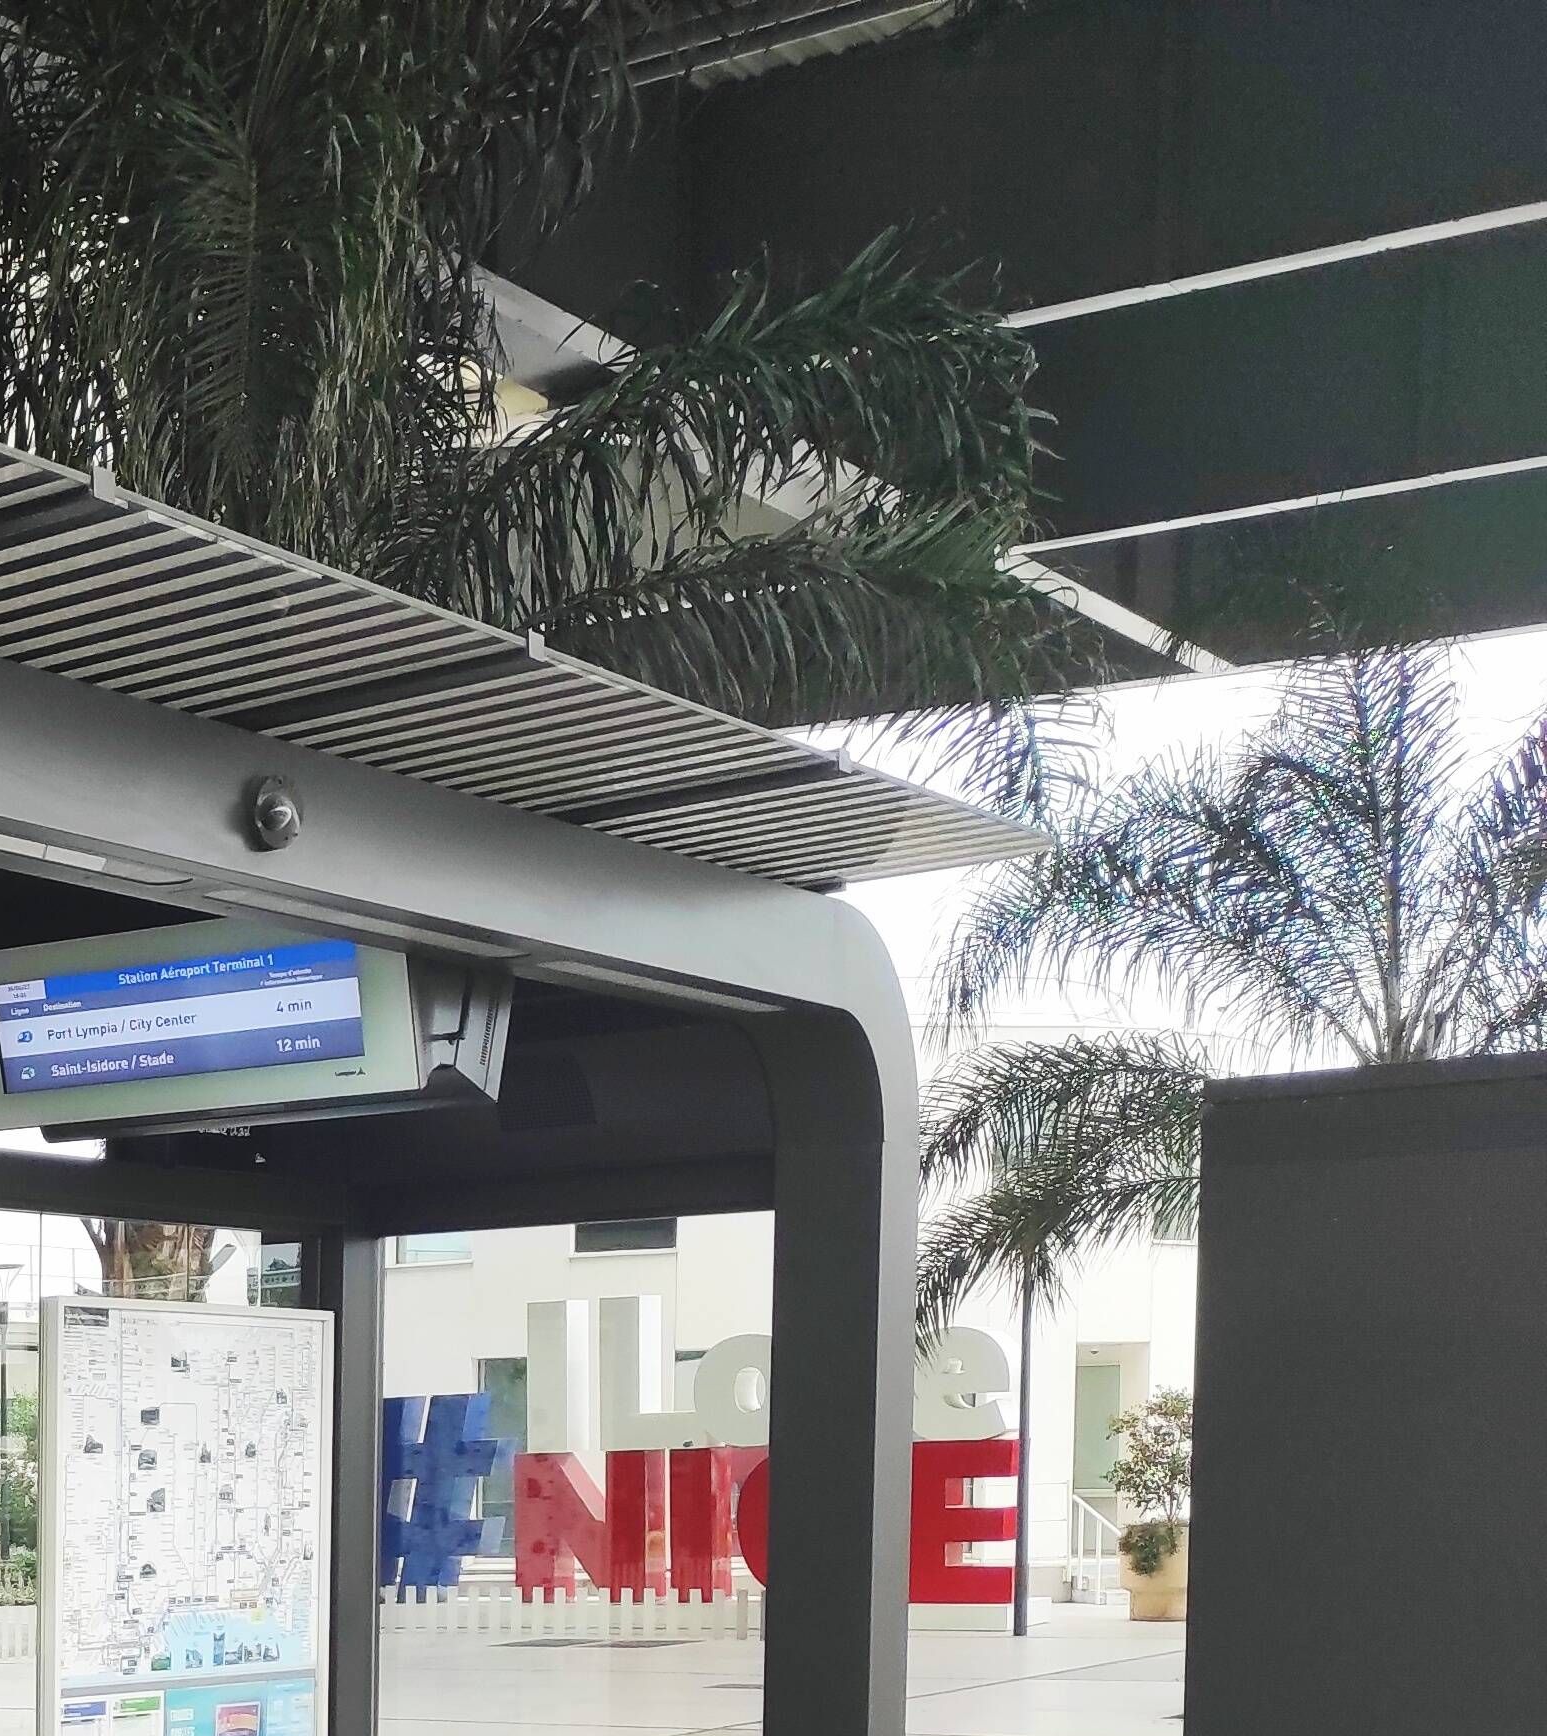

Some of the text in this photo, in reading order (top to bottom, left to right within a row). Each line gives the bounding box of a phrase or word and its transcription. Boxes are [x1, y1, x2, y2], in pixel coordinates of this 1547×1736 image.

[119, 954, 273, 985] Station Aéroport Terminal 1
[277, 1000, 311, 1012] 4 min
[48, 1029, 71, 1040] Port
[77, 1022, 117, 1038] Lympia
[130, 1018, 151, 1031] City
[156, 1014, 196, 1026] Center
[277, 1035, 320, 1052] 12 min
[51, 1057, 128, 1077] Saint-Isidore
[140, 1051, 174, 1066] Stade
